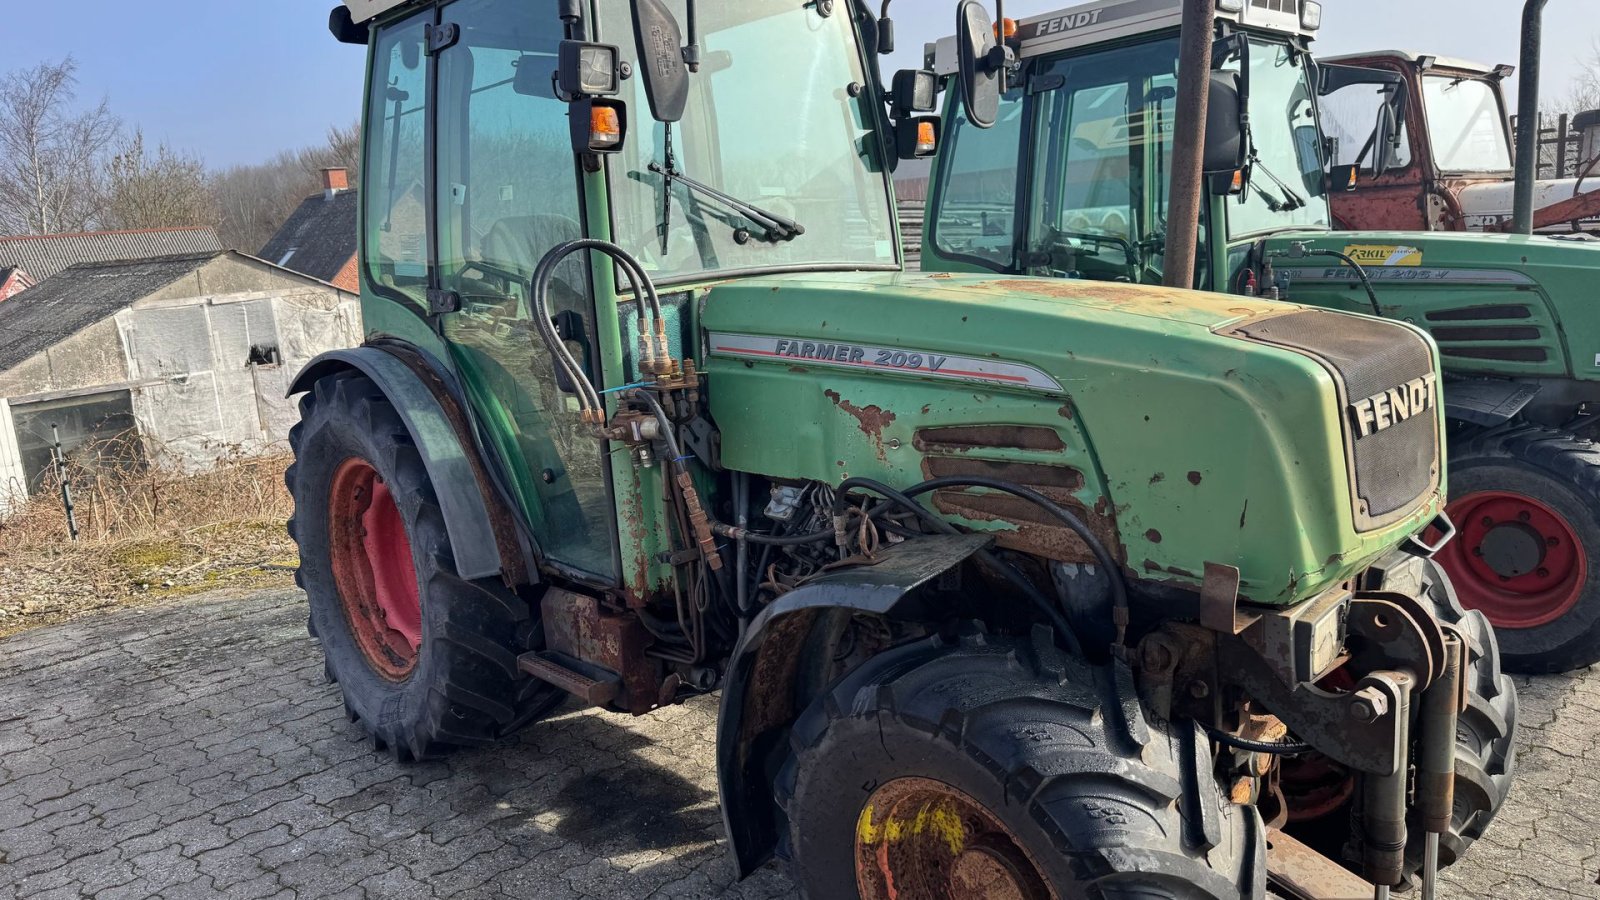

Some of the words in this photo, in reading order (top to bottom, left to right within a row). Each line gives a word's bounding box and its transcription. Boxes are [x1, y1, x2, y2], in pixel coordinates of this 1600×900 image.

[1035, 9, 1103, 36] FENDT
[1348, 249, 1386, 259] ARKIL
[1434, 270, 1449, 279] V
[775, 340, 865, 363] FARMER
[874, 350, 923, 369] 209
[928, 356, 947, 371] V
[1349, 371, 1436, 440] FENDT
